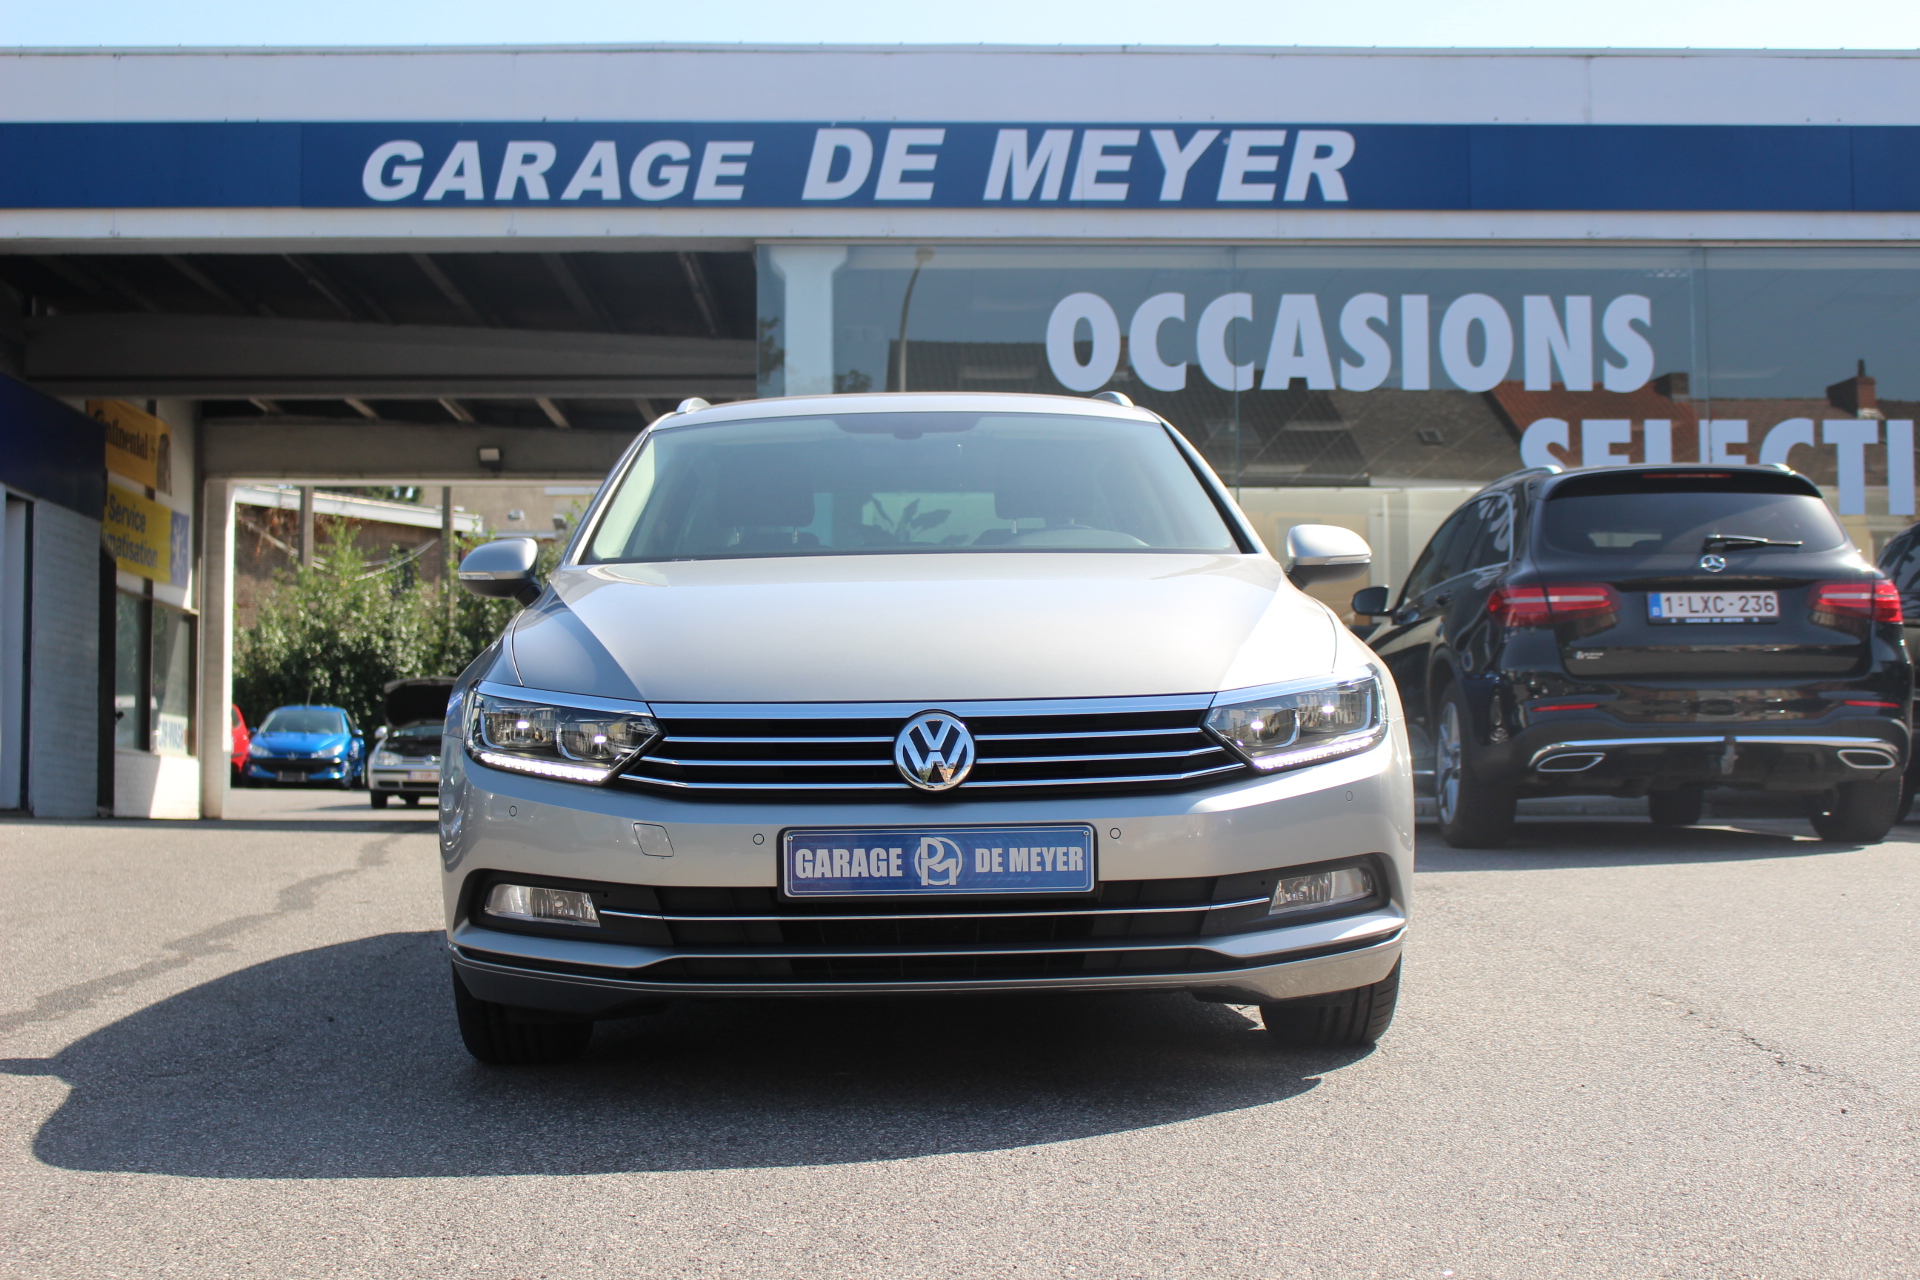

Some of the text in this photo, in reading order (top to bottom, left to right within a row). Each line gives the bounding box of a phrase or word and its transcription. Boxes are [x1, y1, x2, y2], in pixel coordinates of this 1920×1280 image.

[362, 128, 1356, 201] GARAGE DE MEYER
[1046, 292, 1654, 393] OCCASIONS
[109, 494, 146, 533] Service
[101, 524, 158, 569] limatisation
[795, 848, 903, 878] GARAGE
[975, 848, 1004, 873] DE
[1009, 846, 1084, 872] MEYER
